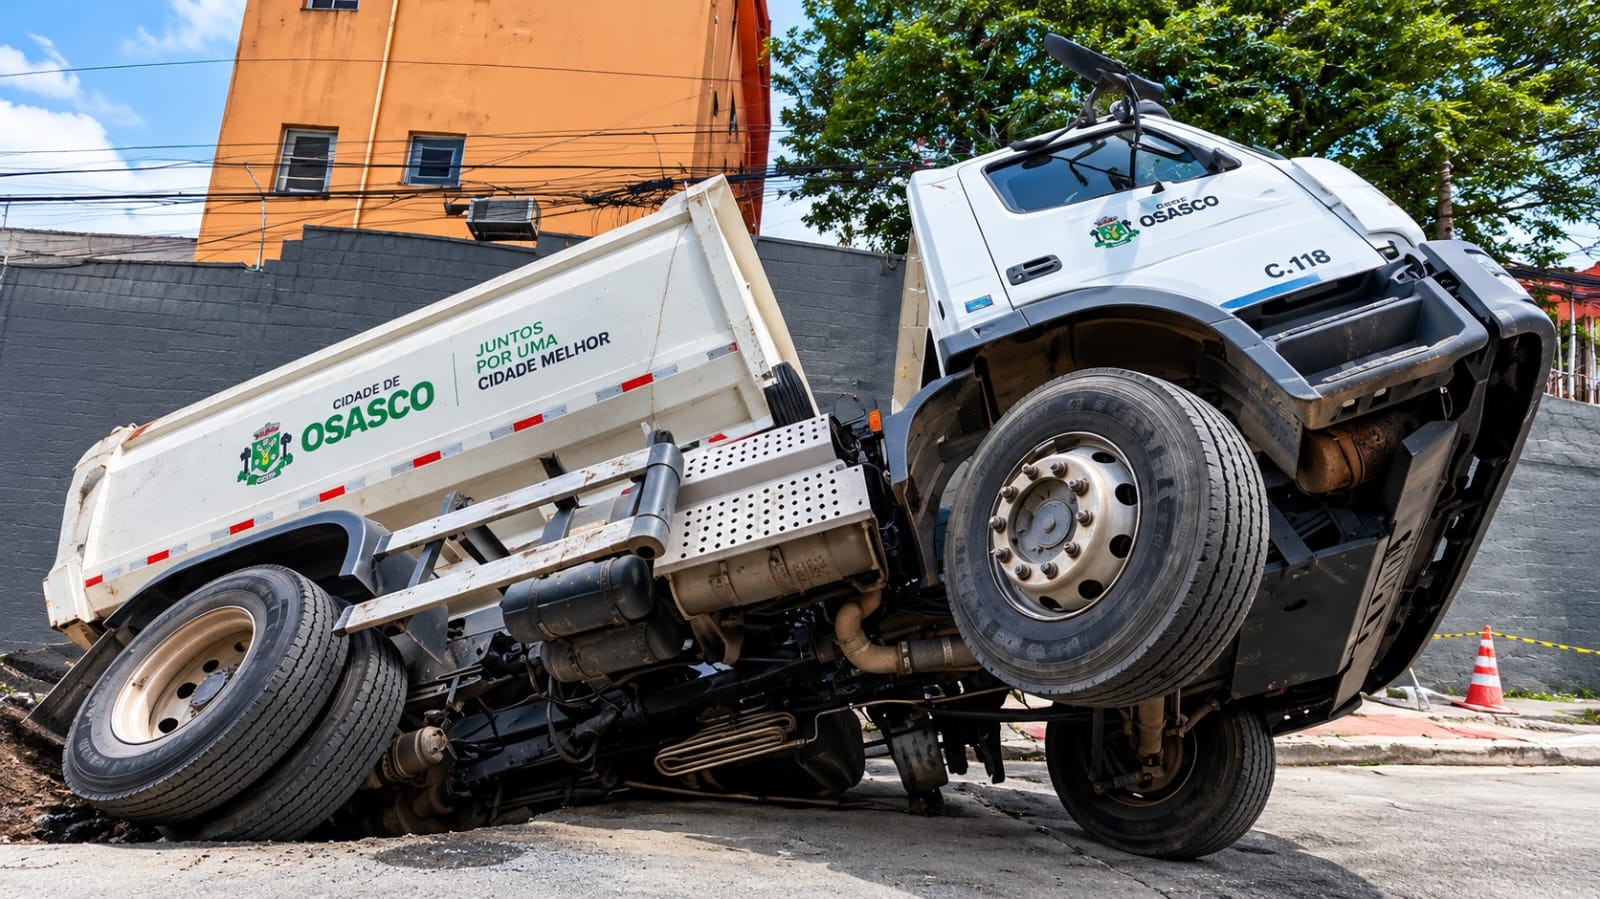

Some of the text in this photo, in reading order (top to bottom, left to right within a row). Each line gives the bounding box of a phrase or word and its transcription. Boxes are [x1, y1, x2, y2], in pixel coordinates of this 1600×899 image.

[1139, 195, 1219, 227] OSASCO
[1264, 249, 1332, 278] C.118
[476, 321, 544, 357] JUNTOS
[476, 333, 558, 374] POR UMA
[478, 331, 611, 391] CIDADE MELHOR
[333, 375, 400, 410] CIDADE DE
[301, 381, 435, 453] OSASCO
